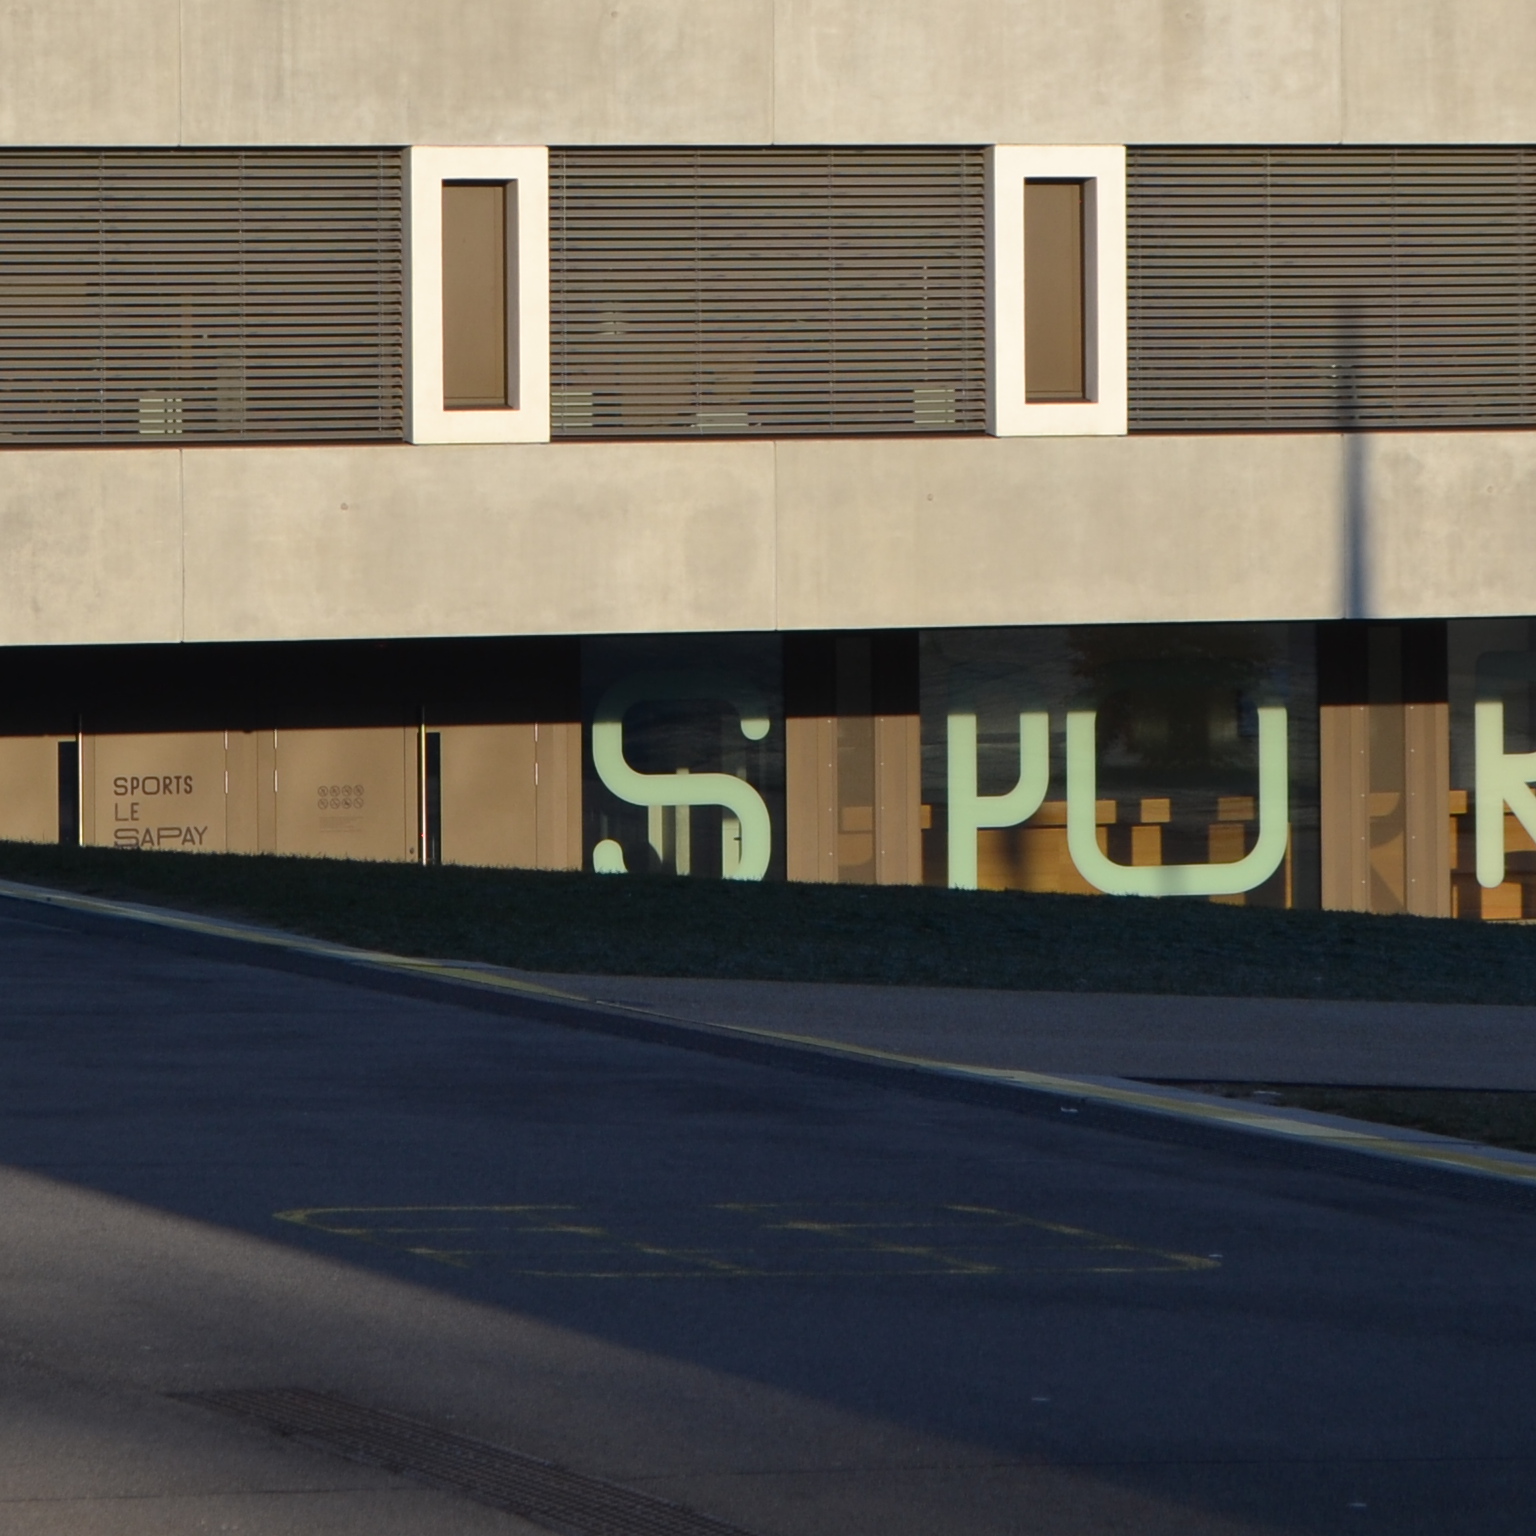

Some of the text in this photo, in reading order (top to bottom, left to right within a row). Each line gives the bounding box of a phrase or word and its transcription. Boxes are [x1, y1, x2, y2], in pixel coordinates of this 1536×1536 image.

[114, 776, 193, 796] SPORTS
[115, 803, 140, 822] LE
[114, 826, 208, 847] SAPAY
